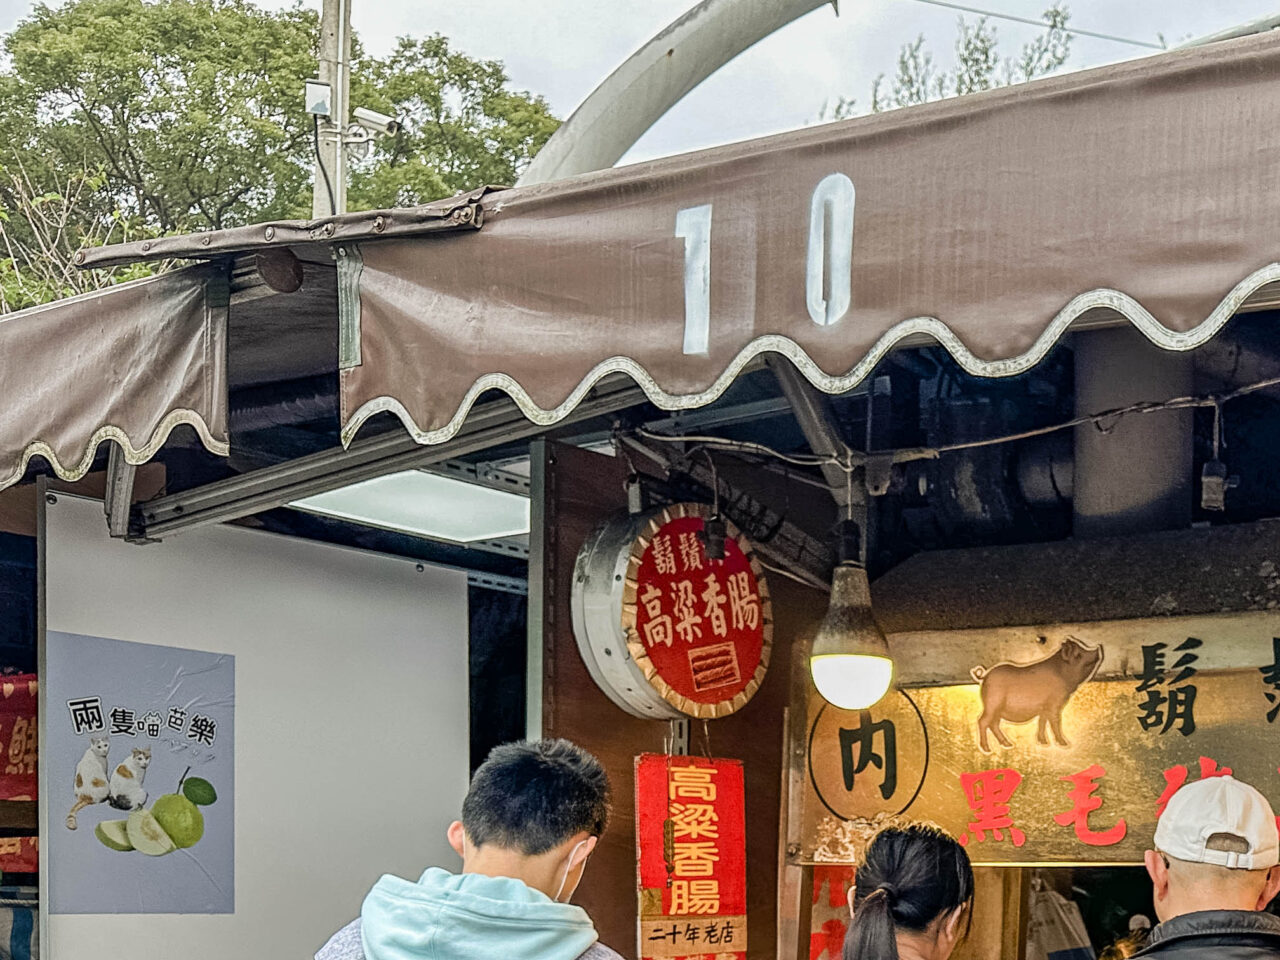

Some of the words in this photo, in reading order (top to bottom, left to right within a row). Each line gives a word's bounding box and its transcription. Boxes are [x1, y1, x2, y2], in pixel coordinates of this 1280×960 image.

[651, 531, 732, 576] 鬍鬚
[639, 571, 760, 649] 高粱香腸
[67, 696, 217, 747] 兩隻喵芭樂
[667, 764, 721, 916] 高粱香腸
[647, 920, 735, 947] 二十年老店
